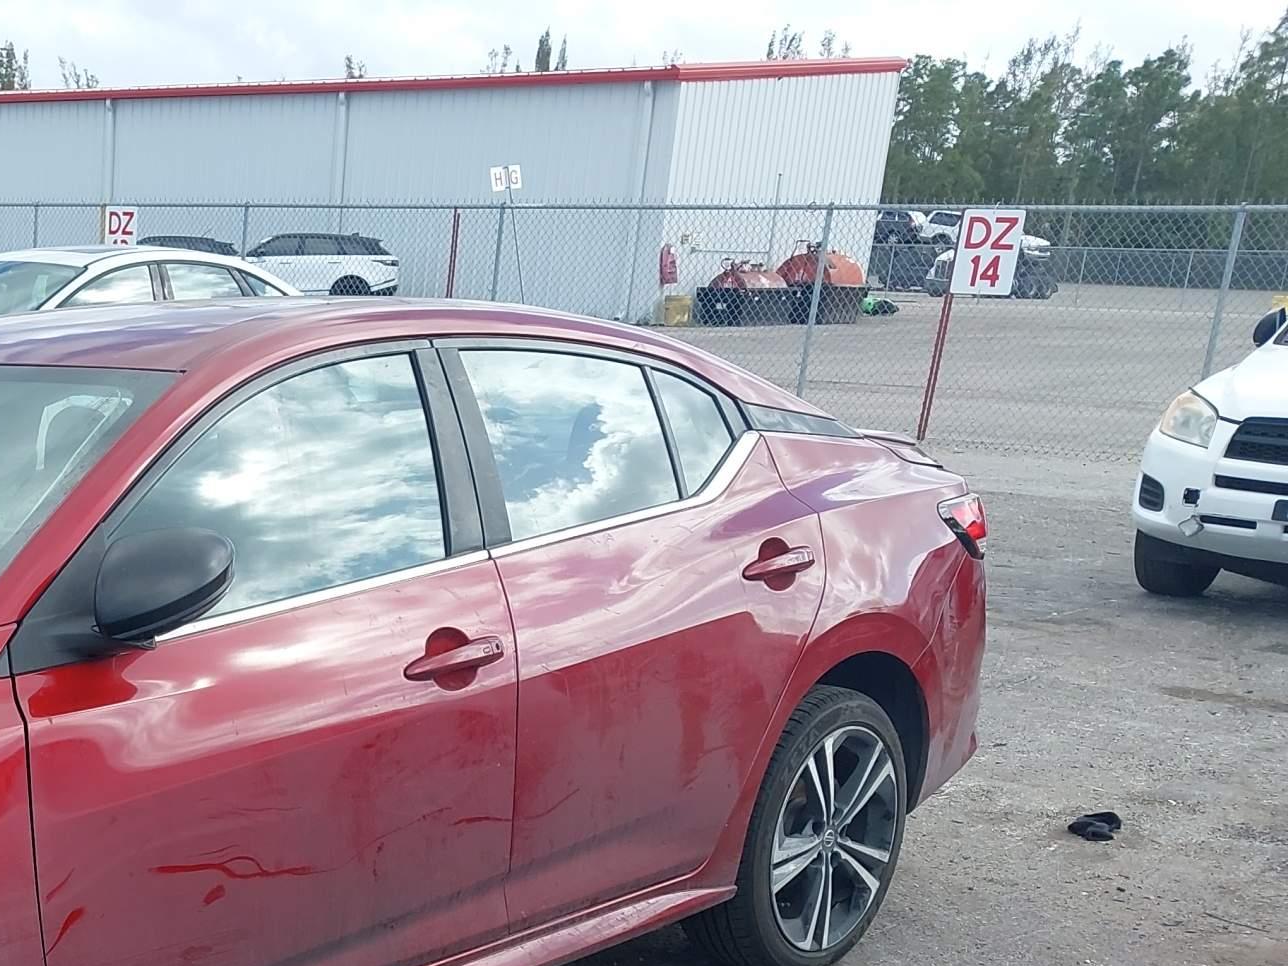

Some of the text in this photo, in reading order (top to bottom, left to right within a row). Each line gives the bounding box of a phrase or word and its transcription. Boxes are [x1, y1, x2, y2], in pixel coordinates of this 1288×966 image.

[108, 211, 135, 236] DZ
[963, 216, 1020, 250] DZ
[969, 255, 1001, 288] 14
